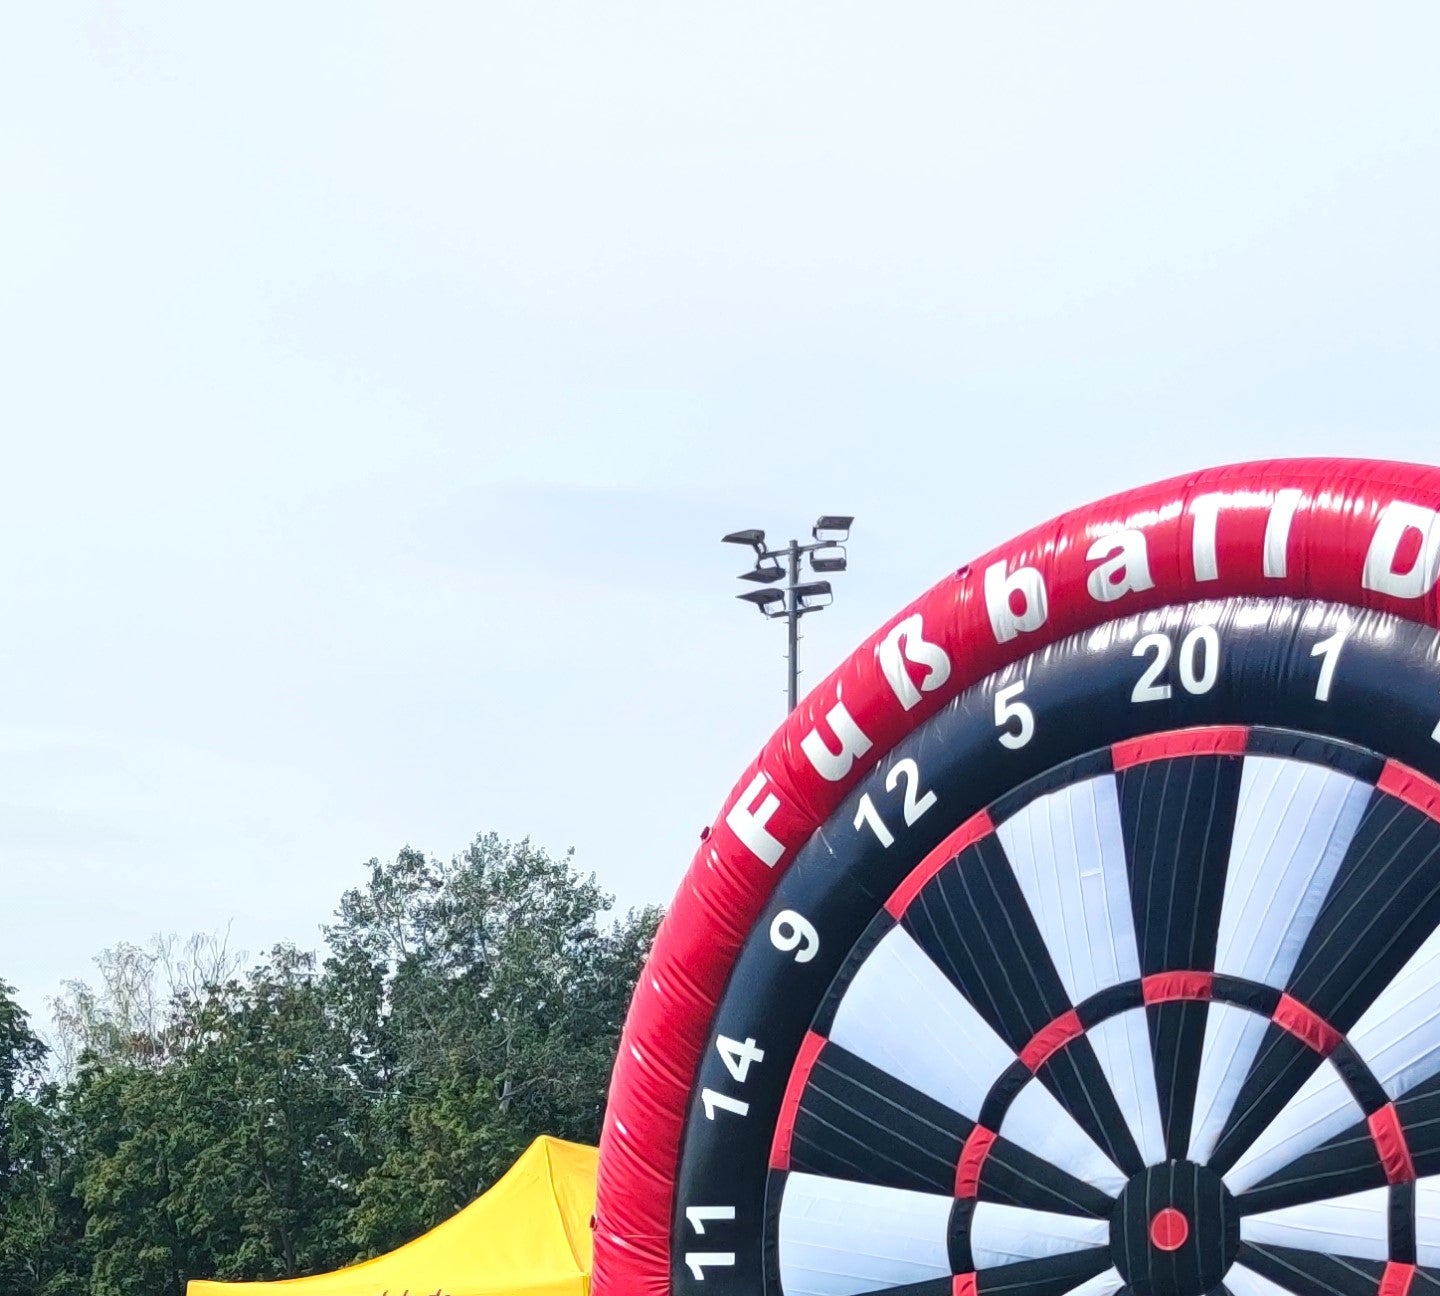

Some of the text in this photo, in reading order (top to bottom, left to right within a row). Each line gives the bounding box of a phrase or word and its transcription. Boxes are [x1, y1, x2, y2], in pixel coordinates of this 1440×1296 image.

[726, 488, 1302, 868] Fußball
[1131, 625, 1219, 703] 20
[1310, 632, 1347, 701] 1
[993, 680, 1035, 750] 5
[853, 758, 937, 849] 12
[770, 909, 821, 963] 9
[701, 1034, 765, 1121] 14
[686, 1206, 736, 1281] 11
